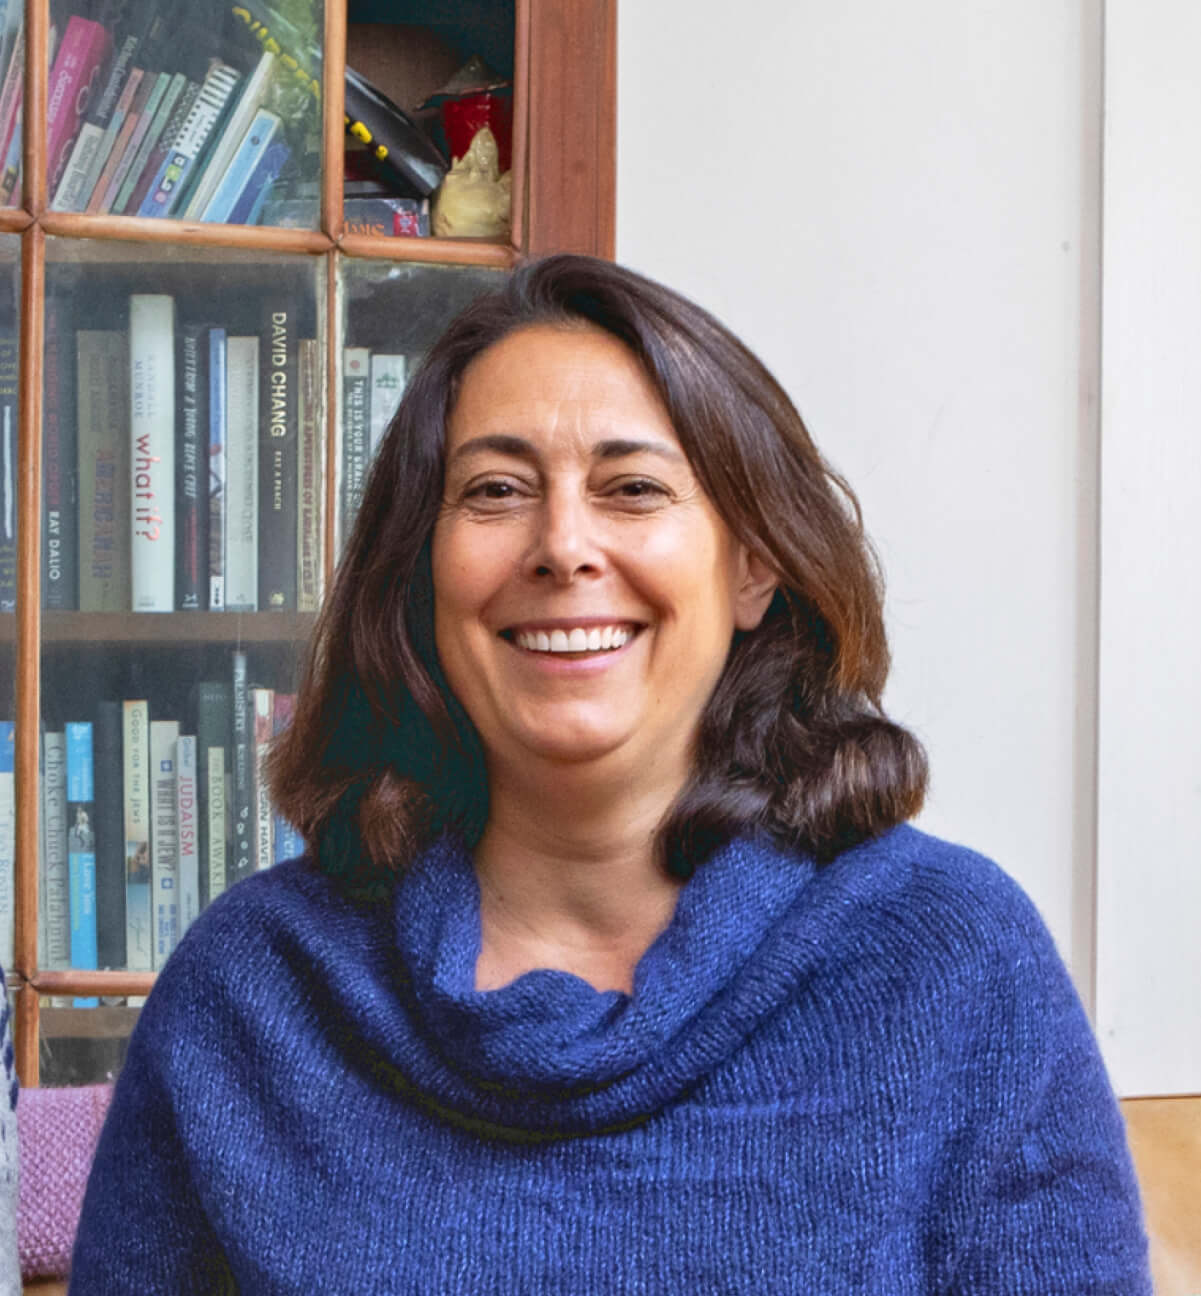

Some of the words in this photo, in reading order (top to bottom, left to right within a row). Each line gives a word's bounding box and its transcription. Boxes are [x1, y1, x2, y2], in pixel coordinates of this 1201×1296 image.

[272, 312, 287, 368] DAVID
[133, 359, 144, 420] MUNROE
[272, 370, 287, 438] CHANG
[353, 381, 365, 405] THIS
[353, 409, 365, 421] IS
[353, 425, 365, 451] YOUR
[136, 433, 161, 501] what
[46, 510, 61, 537] RAY
[136, 507, 164, 542] if?
[46, 539, 61, 582] DALIO
[131, 708, 144, 744] GOOD
[131, 748, 144, 769] FOR
[45, 744, 67, 809] Choke
[131, 773, 144, 793] THE
[131, 798, 144, 825] JEWS
[156, 778, 177, 813] WHAT
[211, 776, 225, 821] BOOK
[156, 815, 177, 828] IS
[179, 775, 196, 858] JUDAISM
[45, 815, 67, 871] Chuck
[156, 839, 177, 874] JEW?
[259, 827, 270, 866] HAVE
